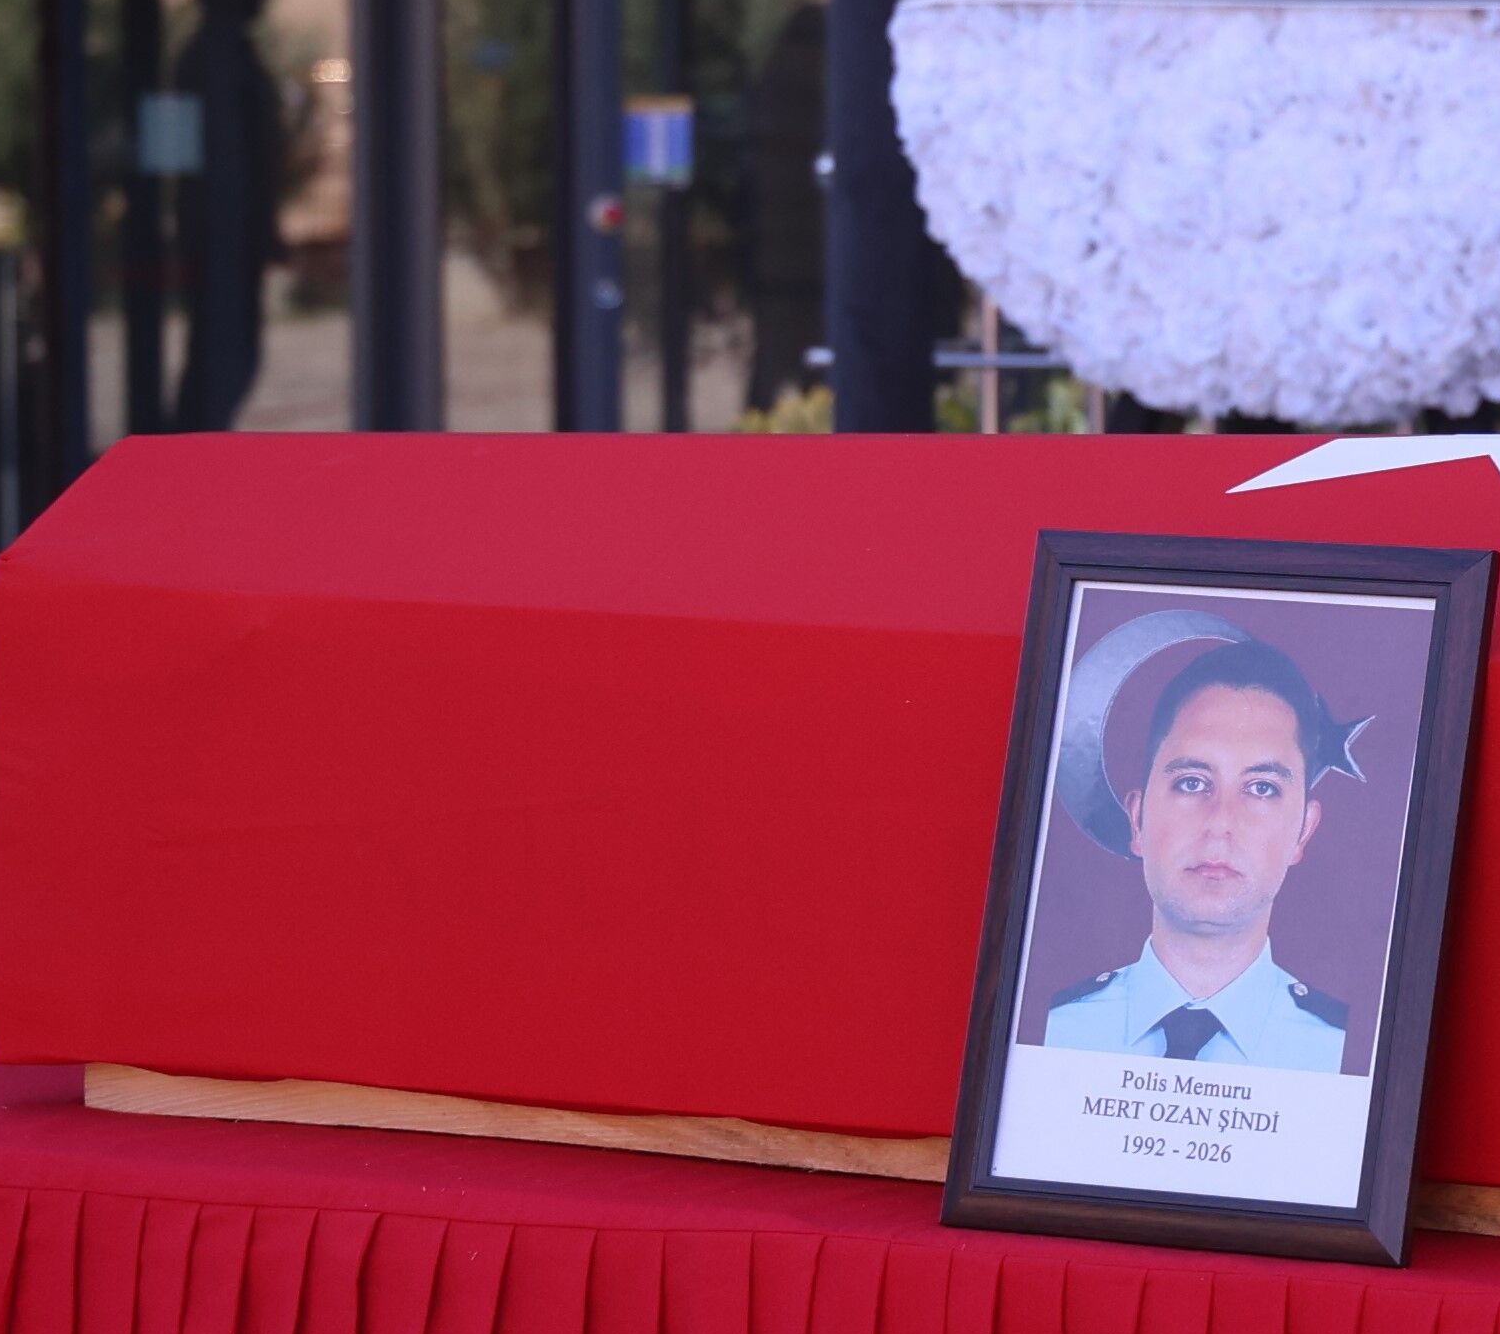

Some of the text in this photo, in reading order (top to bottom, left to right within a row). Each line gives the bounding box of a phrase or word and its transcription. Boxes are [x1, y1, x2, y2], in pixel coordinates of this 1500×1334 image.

[1120, 1070, 1252, 1101] Polis Memuru
[1082, 1096, 1280, 1134] MERT OZAN ŞİNDİ
[1121, 1134, 1167, 1157] 1992
[1185, 1140, 1233, 1164] 2026
